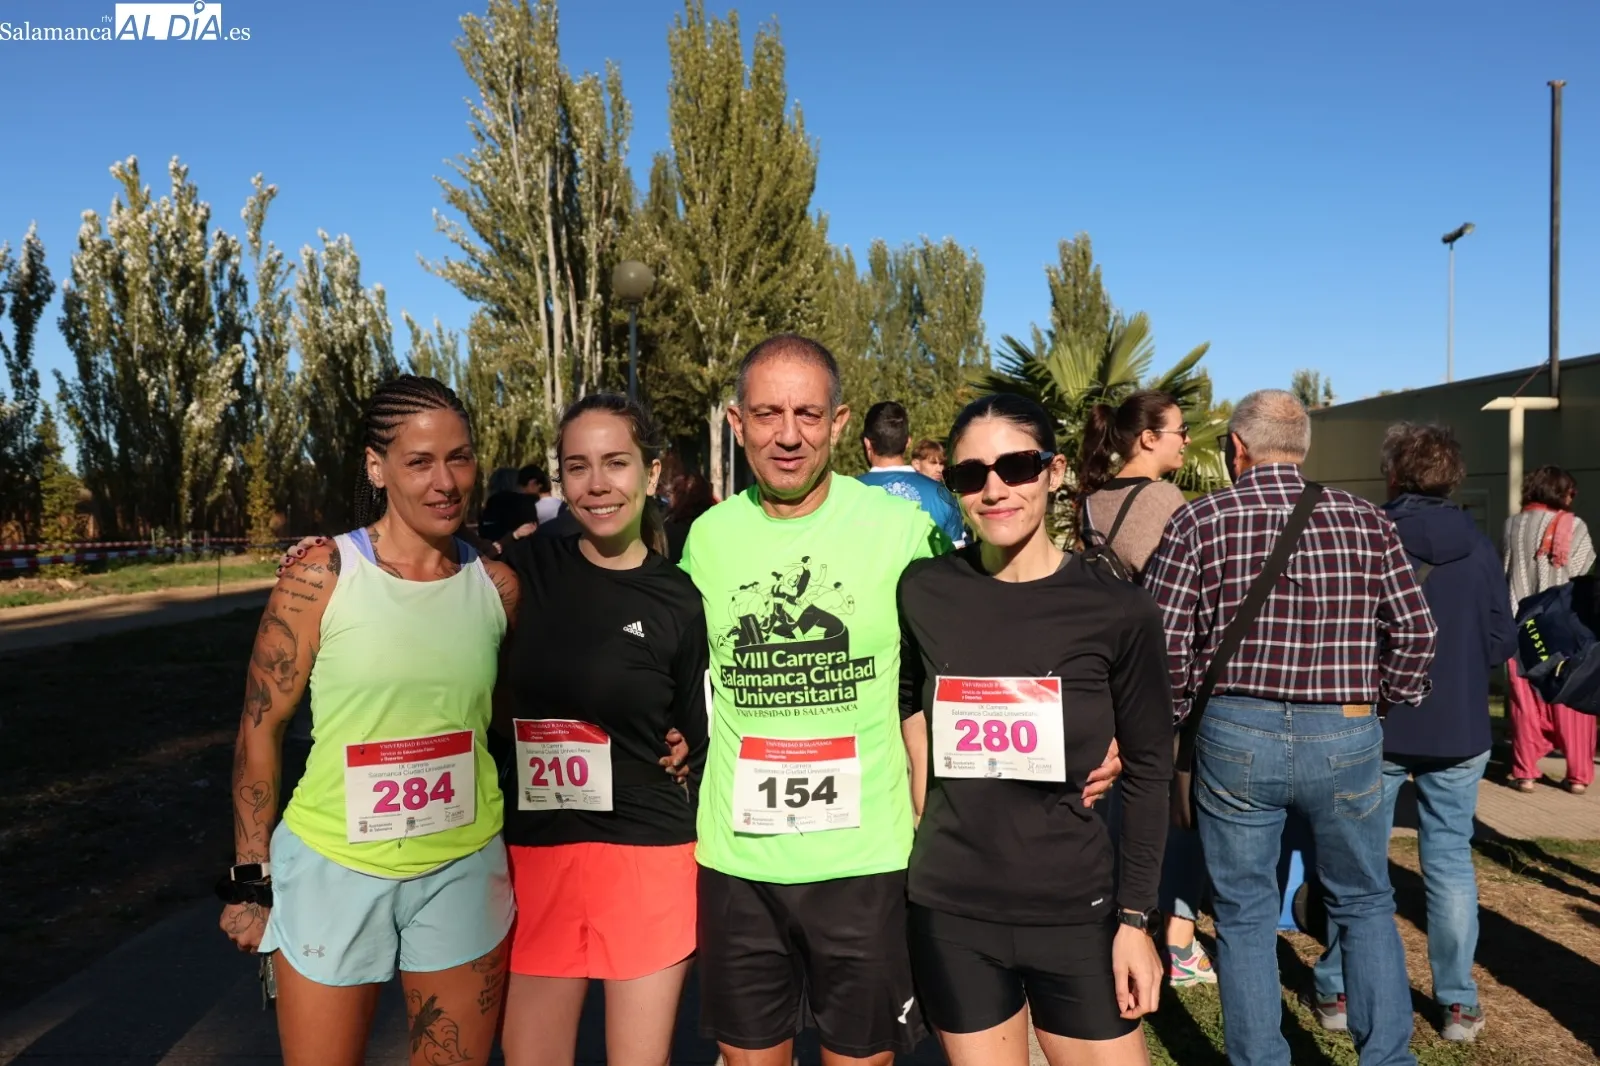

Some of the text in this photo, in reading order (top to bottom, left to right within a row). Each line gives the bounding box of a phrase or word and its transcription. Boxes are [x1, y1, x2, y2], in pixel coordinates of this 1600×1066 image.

[622, 626, 645, 638] adidas
[735, 650, 847, 669] VIII Carrera
[721, 659, 874, 688] Salamanca Ciudad
[736, 686, 855, 705] Universitaria
[802, 704, 859, 716] SALAMANCA
[954, 718, 1038, 754] 280
[403, 768, 425, 776] Ciudad
[529, 755, 589, 787] 210
[372, 771, 456, 814] 284
[758, 775, 838, 809] 154
